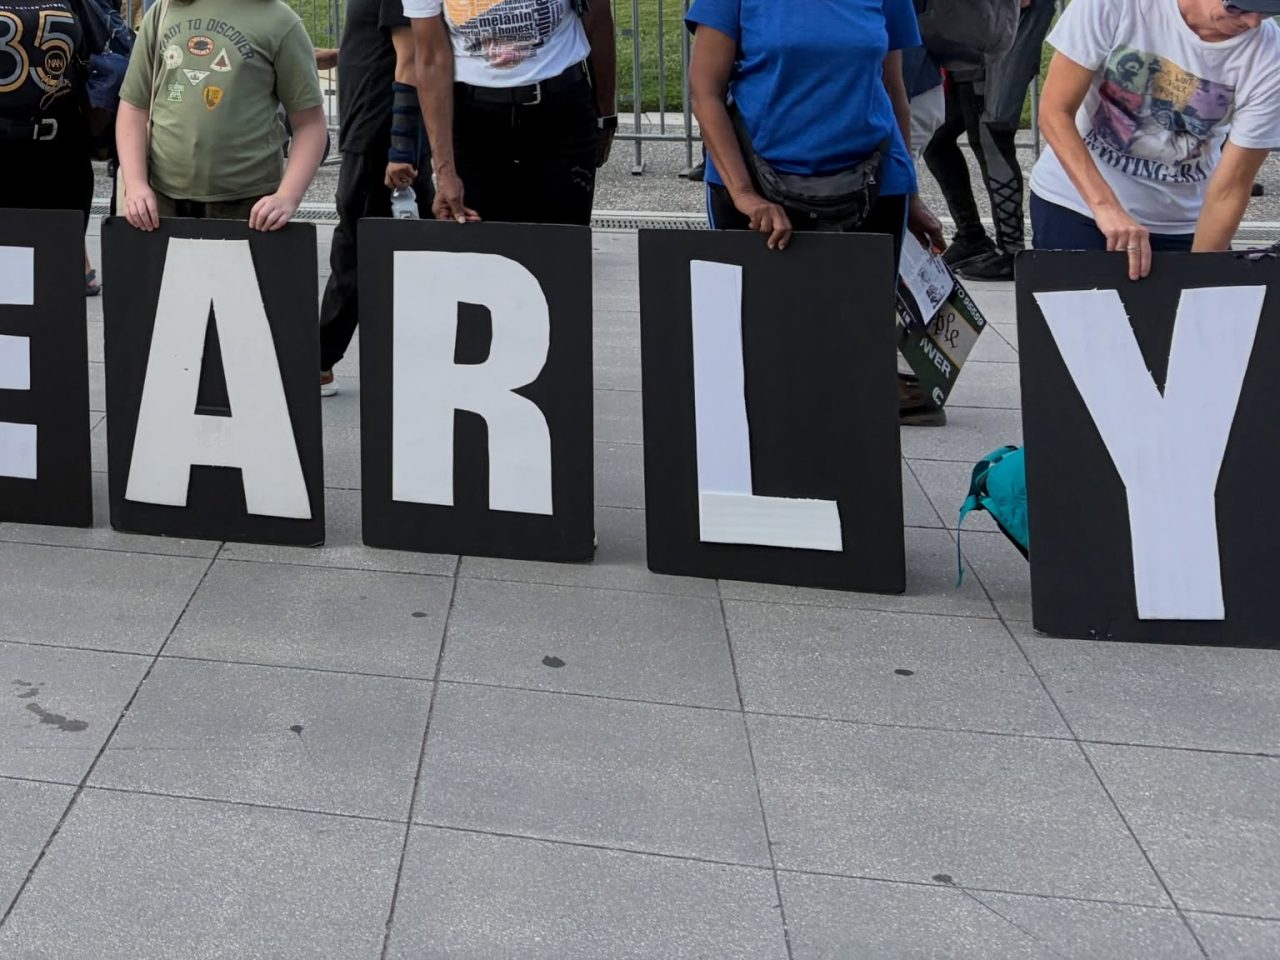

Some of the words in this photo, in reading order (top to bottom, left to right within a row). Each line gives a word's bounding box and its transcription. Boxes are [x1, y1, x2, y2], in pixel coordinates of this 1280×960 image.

[479, 10, 532, 28] melanin
[498, 23, 533, 36] honest
[187, 19, 202, 31] TO
[206, 18, 255, 61] DISCOVER
[1099, 145, 1169, 181] VOTING
